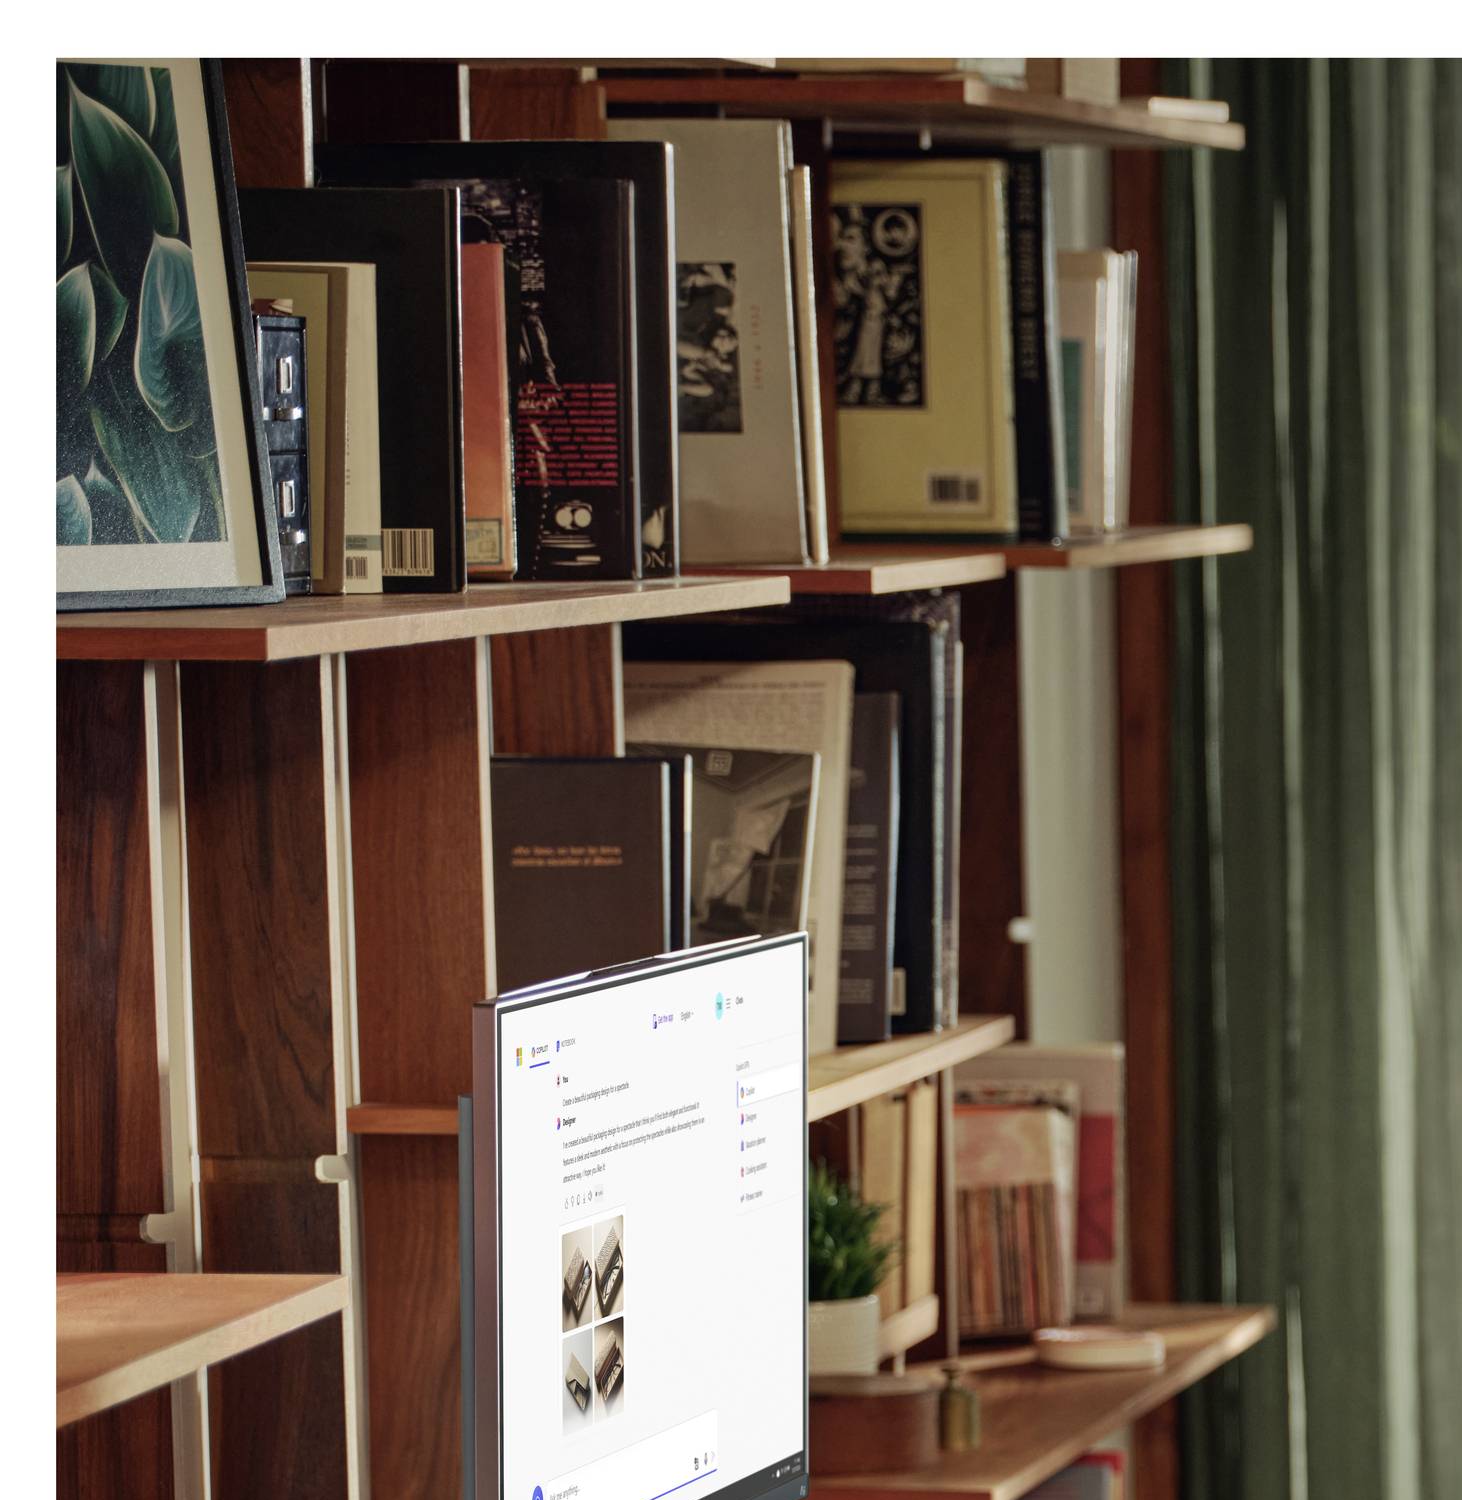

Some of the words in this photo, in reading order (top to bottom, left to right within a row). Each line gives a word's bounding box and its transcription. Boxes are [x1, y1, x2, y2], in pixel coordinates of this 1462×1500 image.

[536, 1045, 548, 1055] COPILOT
[563, 1116, 576, 1129] Designer
[557, 1492, 562, 1500] me
